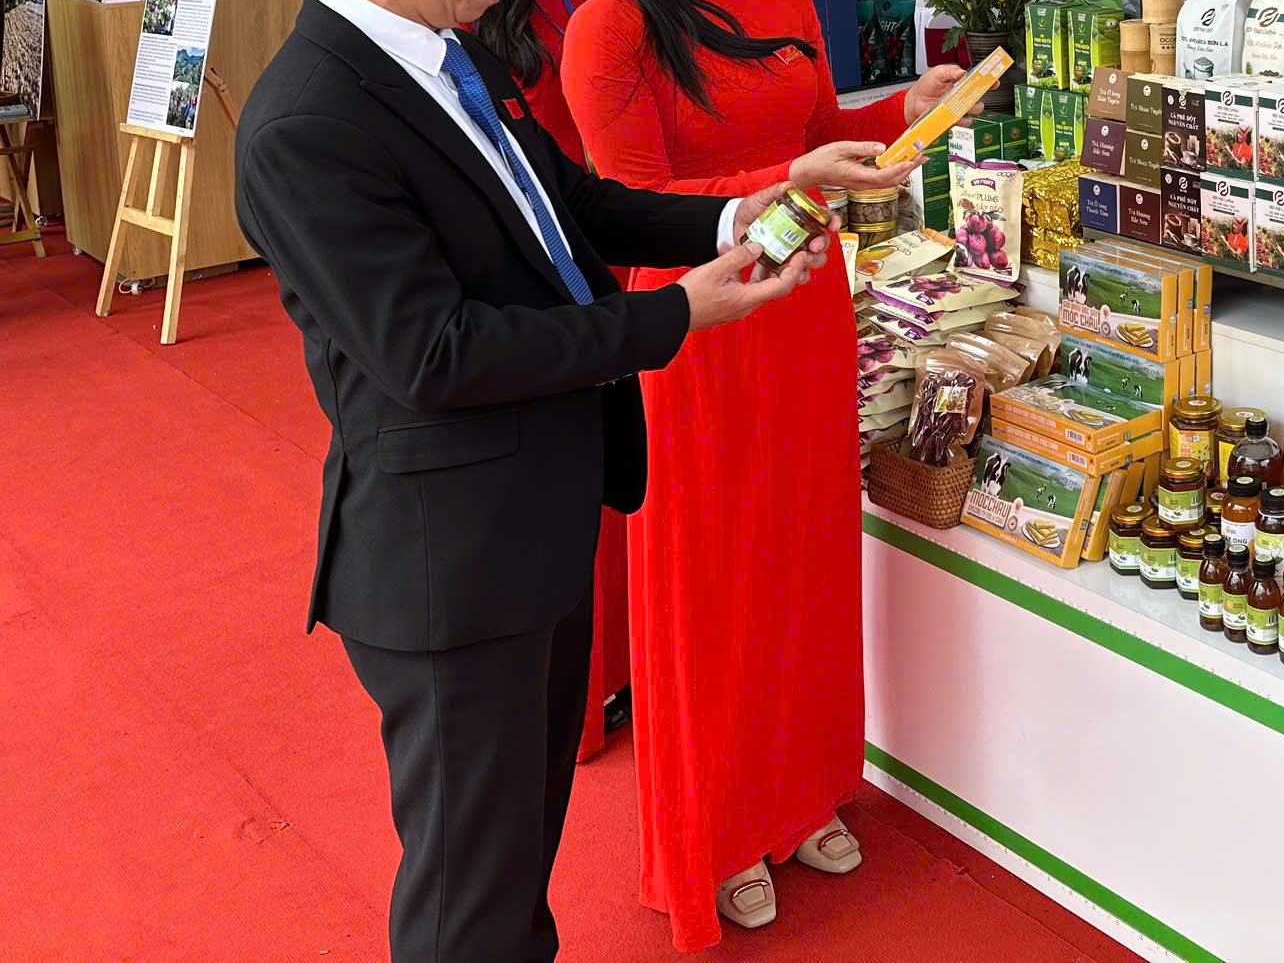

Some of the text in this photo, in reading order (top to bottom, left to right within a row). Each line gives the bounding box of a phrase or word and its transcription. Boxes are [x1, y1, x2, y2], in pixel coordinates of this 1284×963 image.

[1168, 119, 1199, 130] NGUYÊN CHẤT
[977, 194, 998, 202] PLUMS
